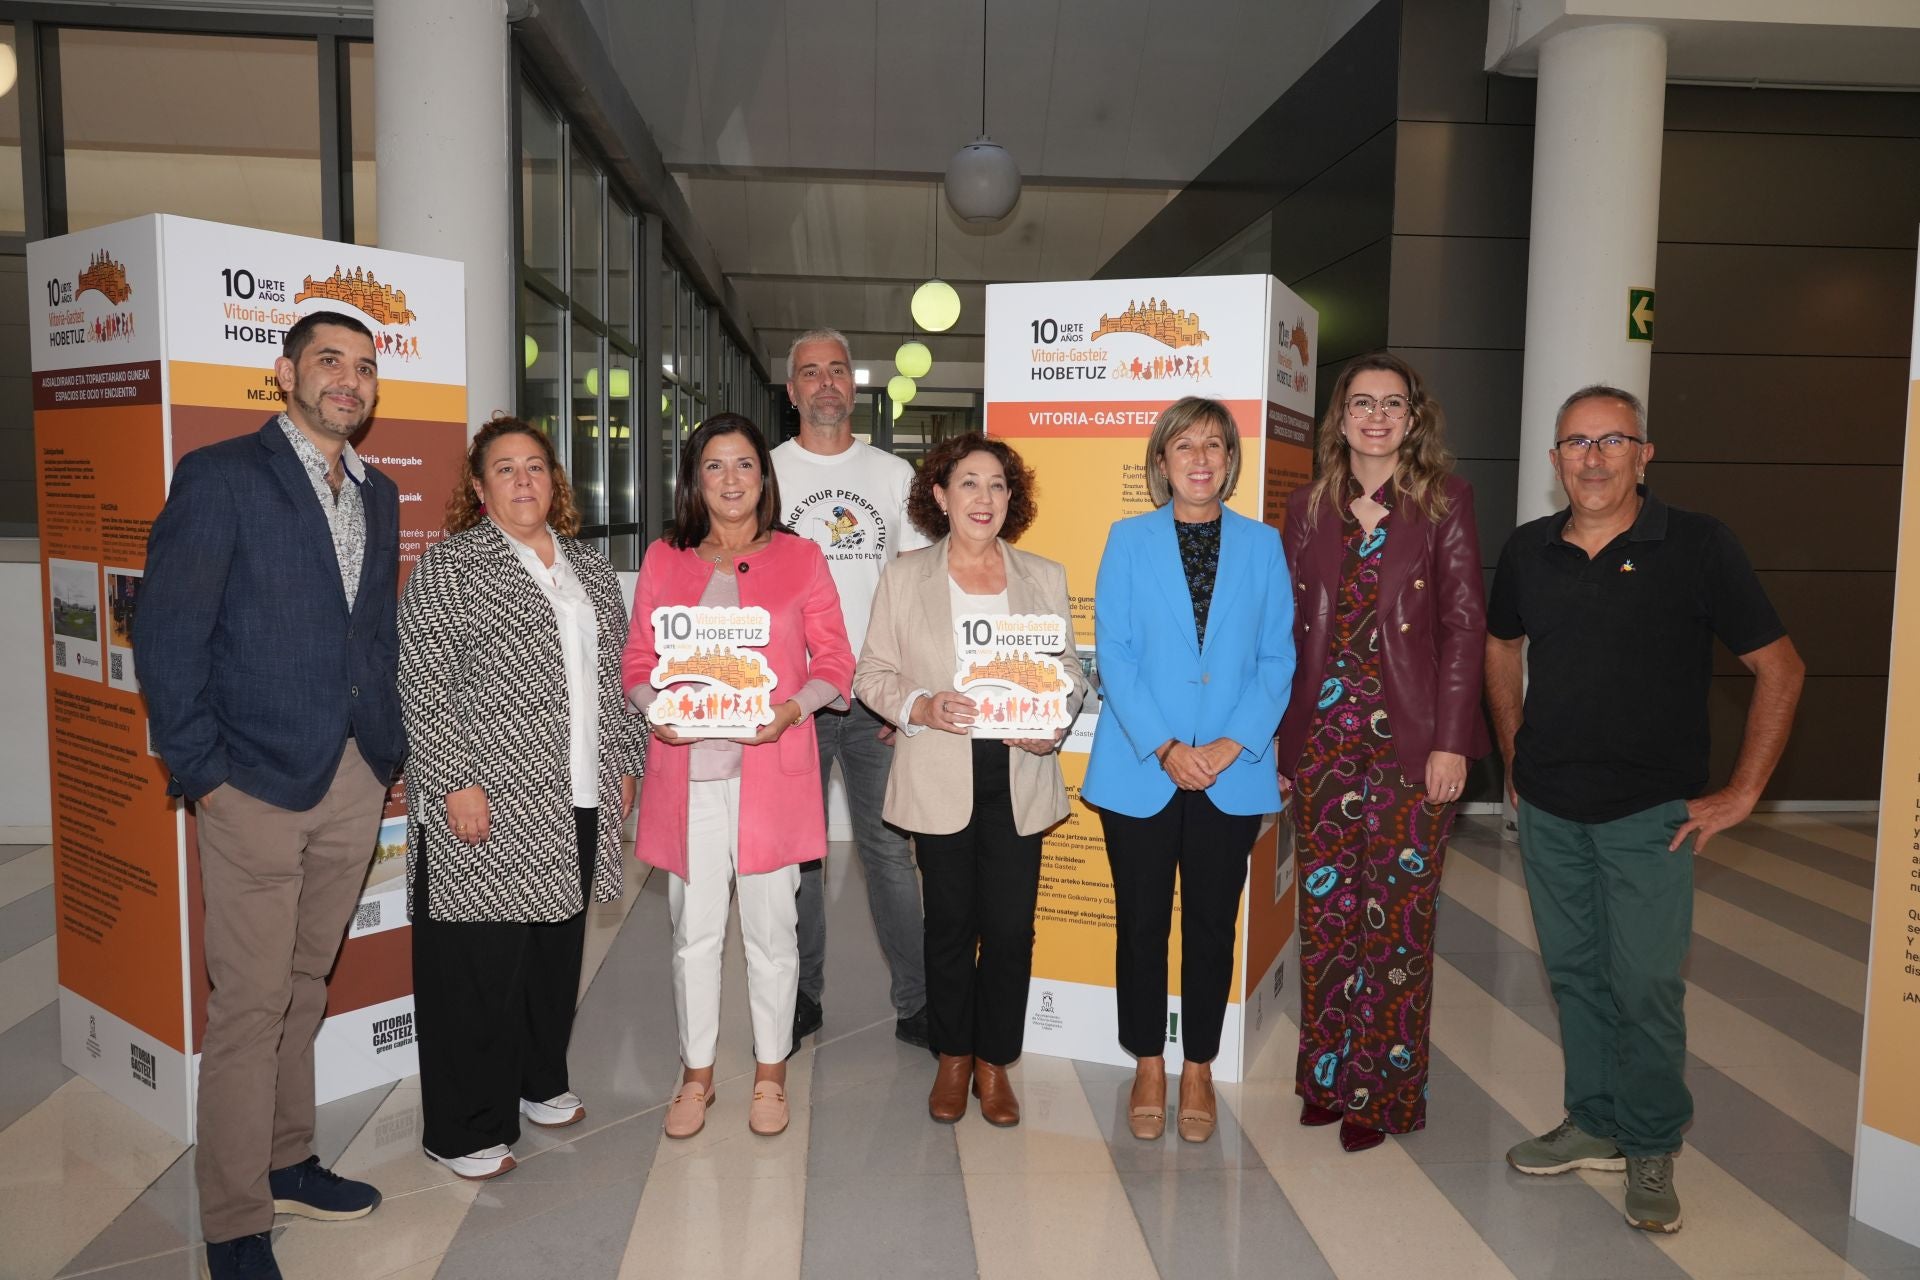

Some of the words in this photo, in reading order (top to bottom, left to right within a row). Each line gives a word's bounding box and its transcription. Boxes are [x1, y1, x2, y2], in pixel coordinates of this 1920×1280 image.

[47, 278, 61, 306] 10
[222, 269, 255, 300] 10
[258, 279, 285, 291] URTE
[259, 291, 285, 302] AÑOS
[50, 328, 85, 346] HOBETUZ
[224, 325, 288, 345] HOBET
[1031, 318, 1058, 344] 10
[1061, 323, 1083, 333] URTE
[1061, 334, 1083, 342] AÑOS
[1031, 346, 1108, 363] Vitoria-Gasteiz
[1031, 366, 1107, 380] HOBETUZ
[105, 386, 137, 398] ENCUENTRO
[247, 389, 287, 401] MEJOR
[1029, 411, 1159, 425] VITORIA-GASTEIZ
[382, 456, 422, 466] etengabe
[787, 505, 805, 529] NGE
[802, 489, 833, 507] YOUR
[836, 489, 886, 552] PERSPECTIVE
[399, 529, 424, 538] nterés
[427, 530, 441, 541] por
[660, 612, 692, 641] 10
[696, 612, 763, 625] Vitoria-Gasteiz
[696, 628, 763, 640] HOBETUZ
[962, 619, 992, 646] 10
[996, 619, 1060, 632] Vitoria-Gasteiz
[996, 635, 1059, 646] HOBETUZ
[1907, 935, 1914, 946] Y
[1904, 963, 1920, 976] dis
[372, 1012, 413, 1034] VITORIA
[372, 1024, 413, 1047] GASTEIZ
[130, 1042, 151, 1066] VITORIA
[130, 1056, 151, 1079] GASTEIZ
